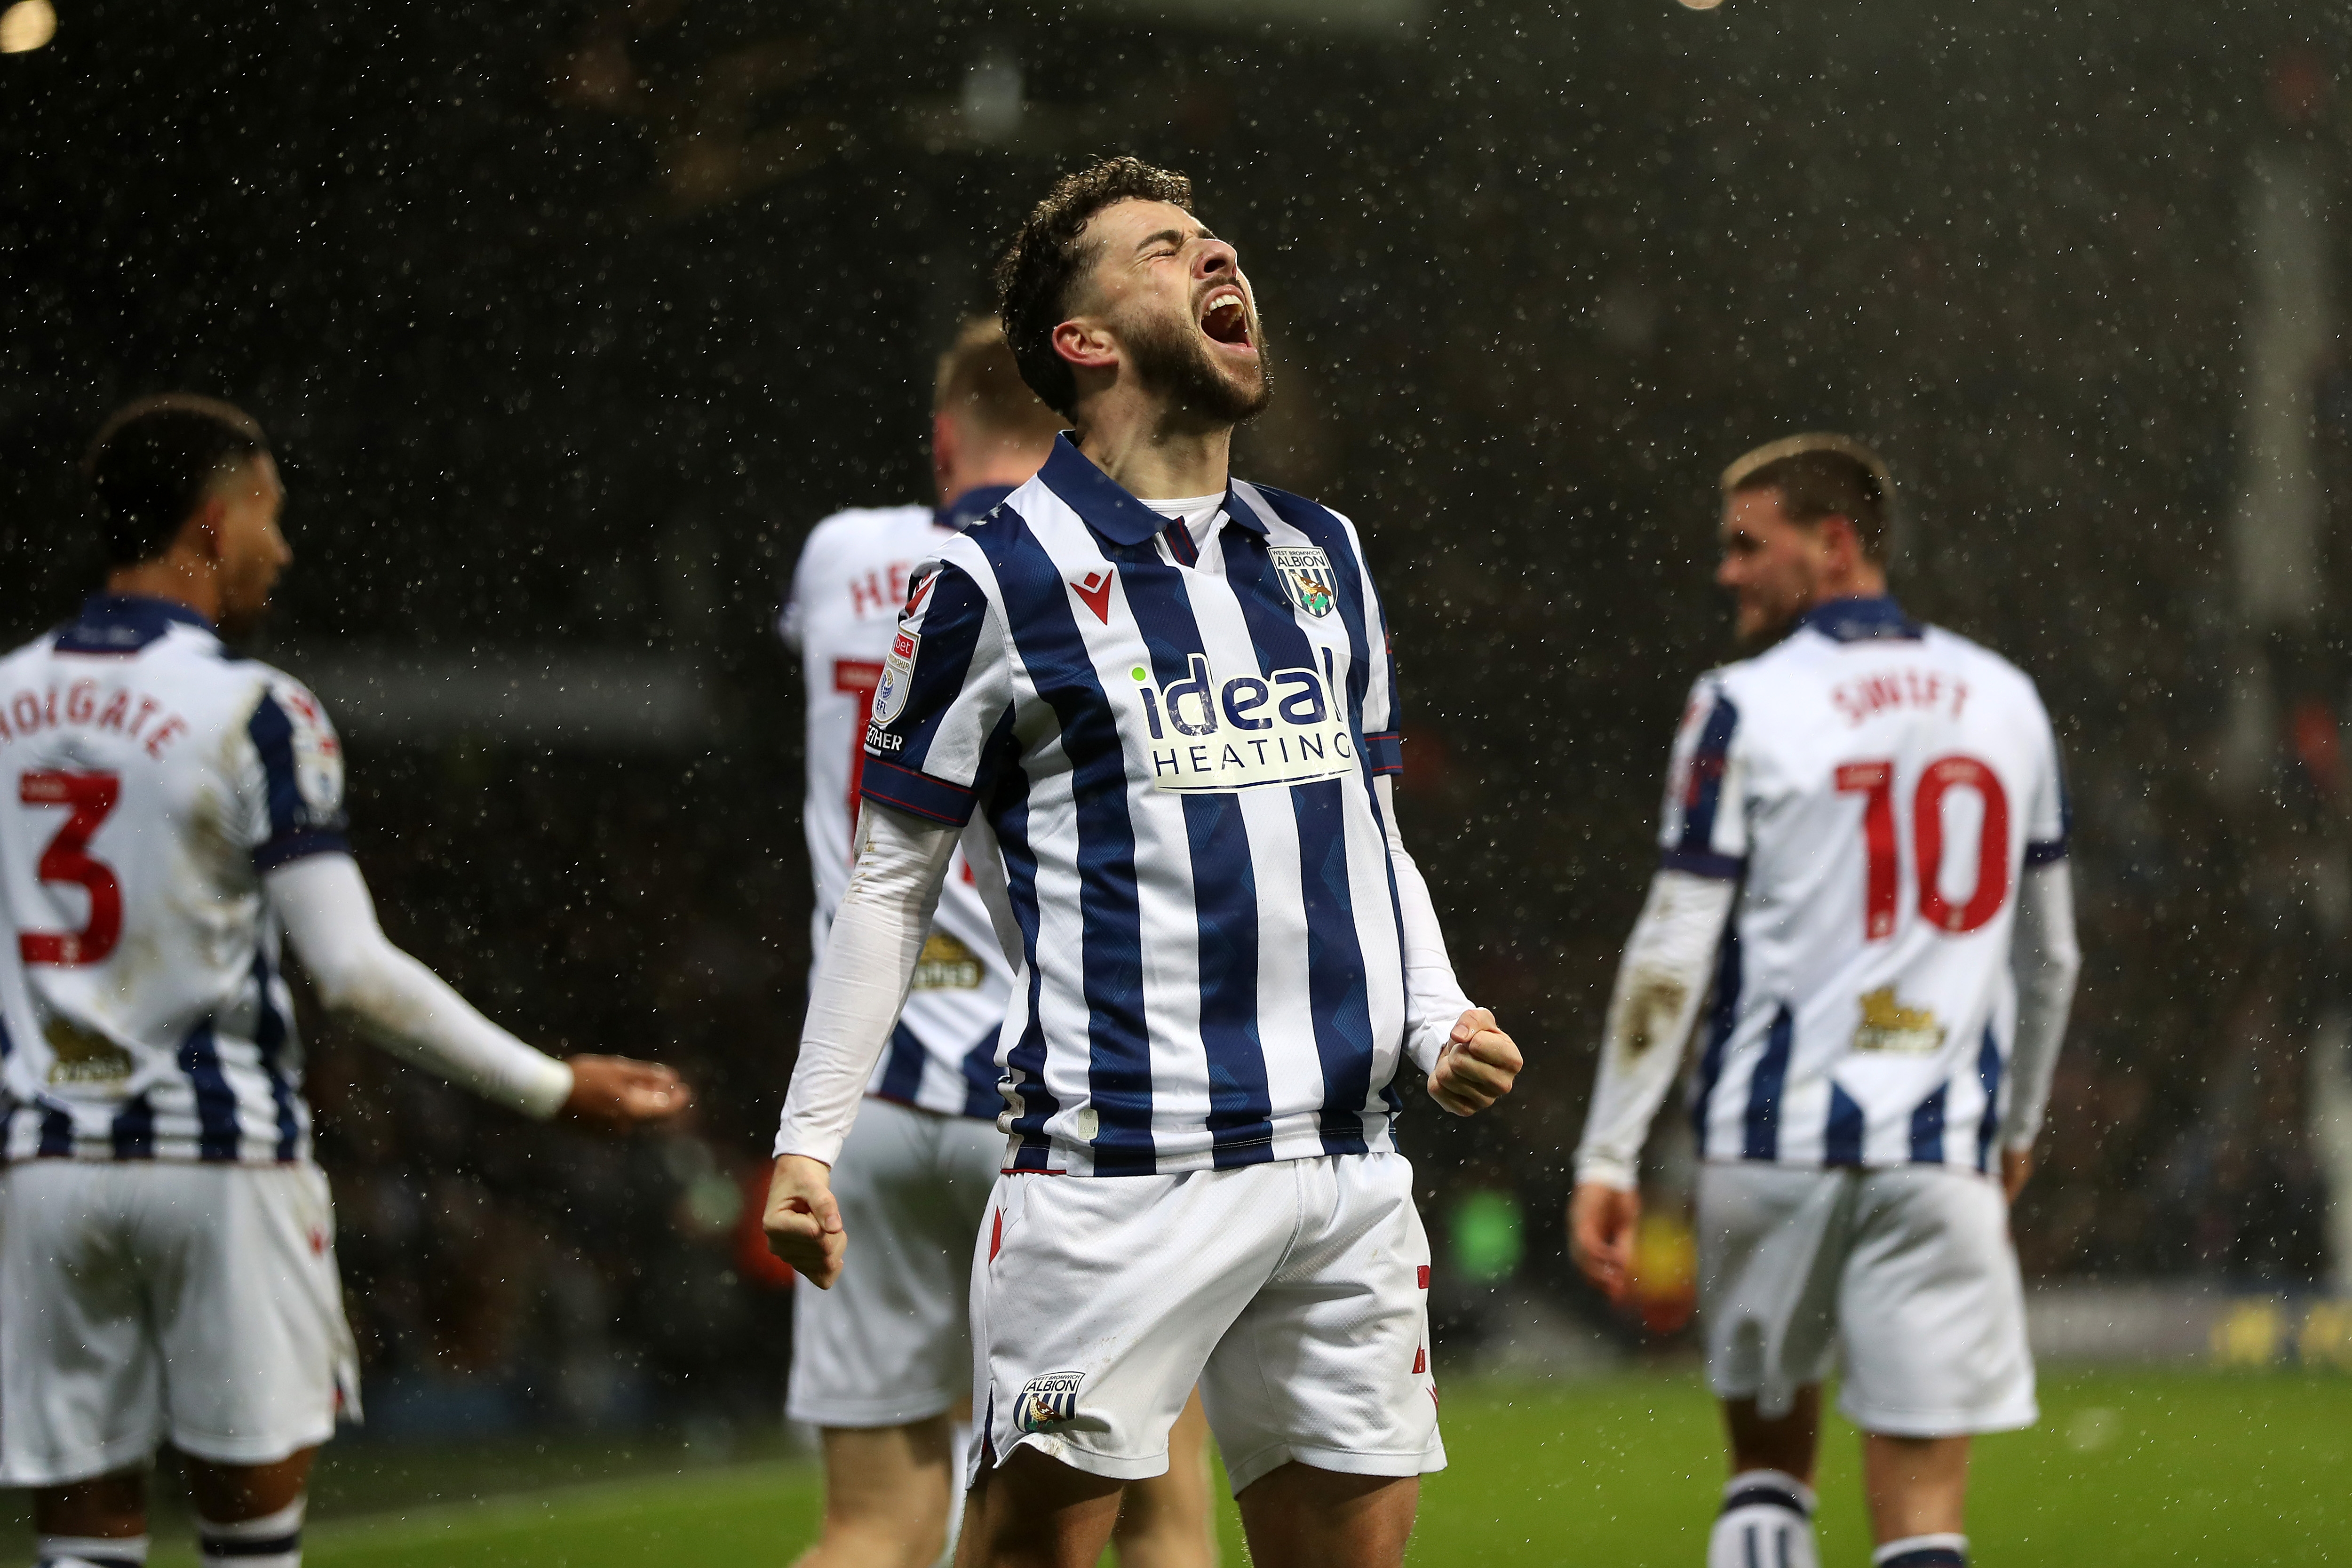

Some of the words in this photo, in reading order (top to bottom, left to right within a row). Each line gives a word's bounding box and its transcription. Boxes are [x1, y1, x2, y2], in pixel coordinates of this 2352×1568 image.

[1278, 556, 1326, 567] ALBION
[896, 636, 911, 654] bet
[876, 698, 886, 715] EFL
[1131, 647, 1342, 740] ideal
[1152, 732, 1351, 777] HEATING
[1834, 754, 2010, 941] 10
[21, 771, 121, 967] 3
[1026, 1380, 1078, 1392] ALBION
